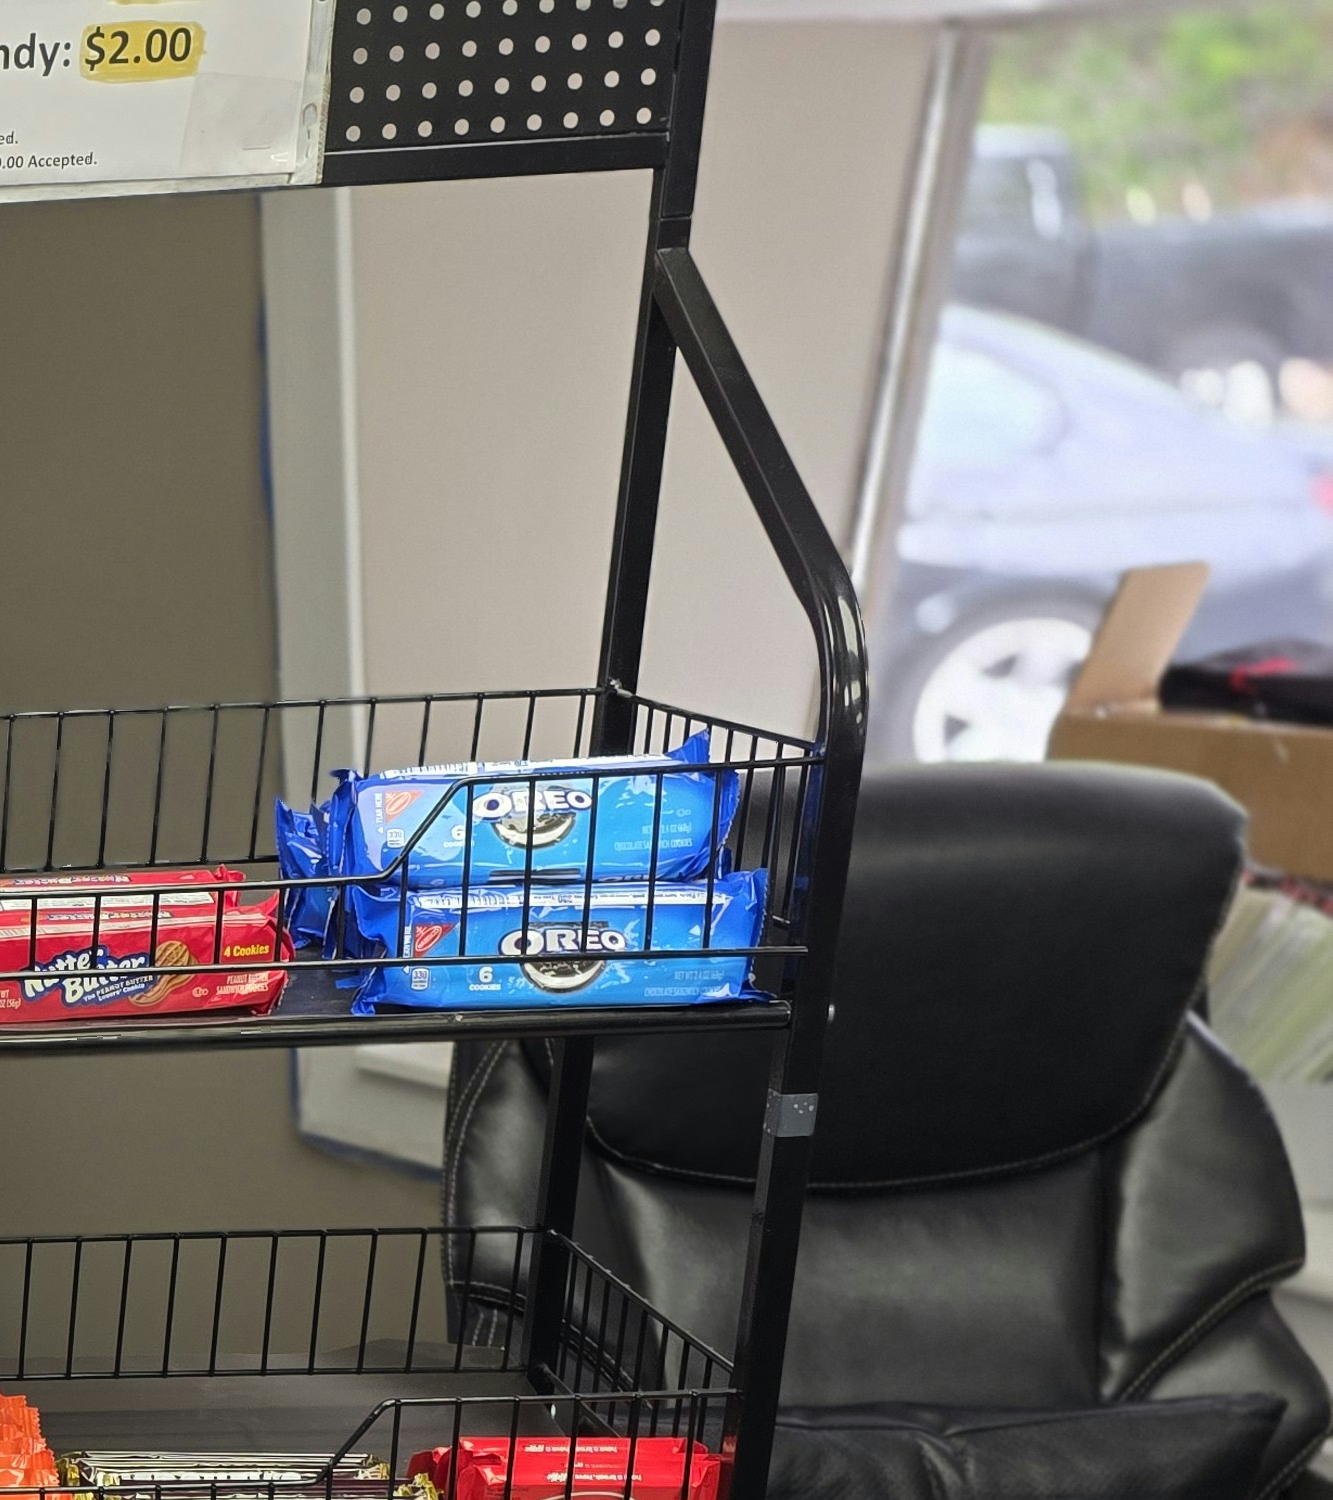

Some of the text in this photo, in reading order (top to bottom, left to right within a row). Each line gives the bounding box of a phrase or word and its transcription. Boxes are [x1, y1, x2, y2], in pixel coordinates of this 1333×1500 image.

[85, 26, 192, 71] $2.00
[28, 152, 97, 169] Accepted.
[473, 790, 592, 819] OREO
[224, 944, 270, 958] 4 Cookies
[500, 929, 626, 955] OREO
[479, 966, 493, 983] 6
